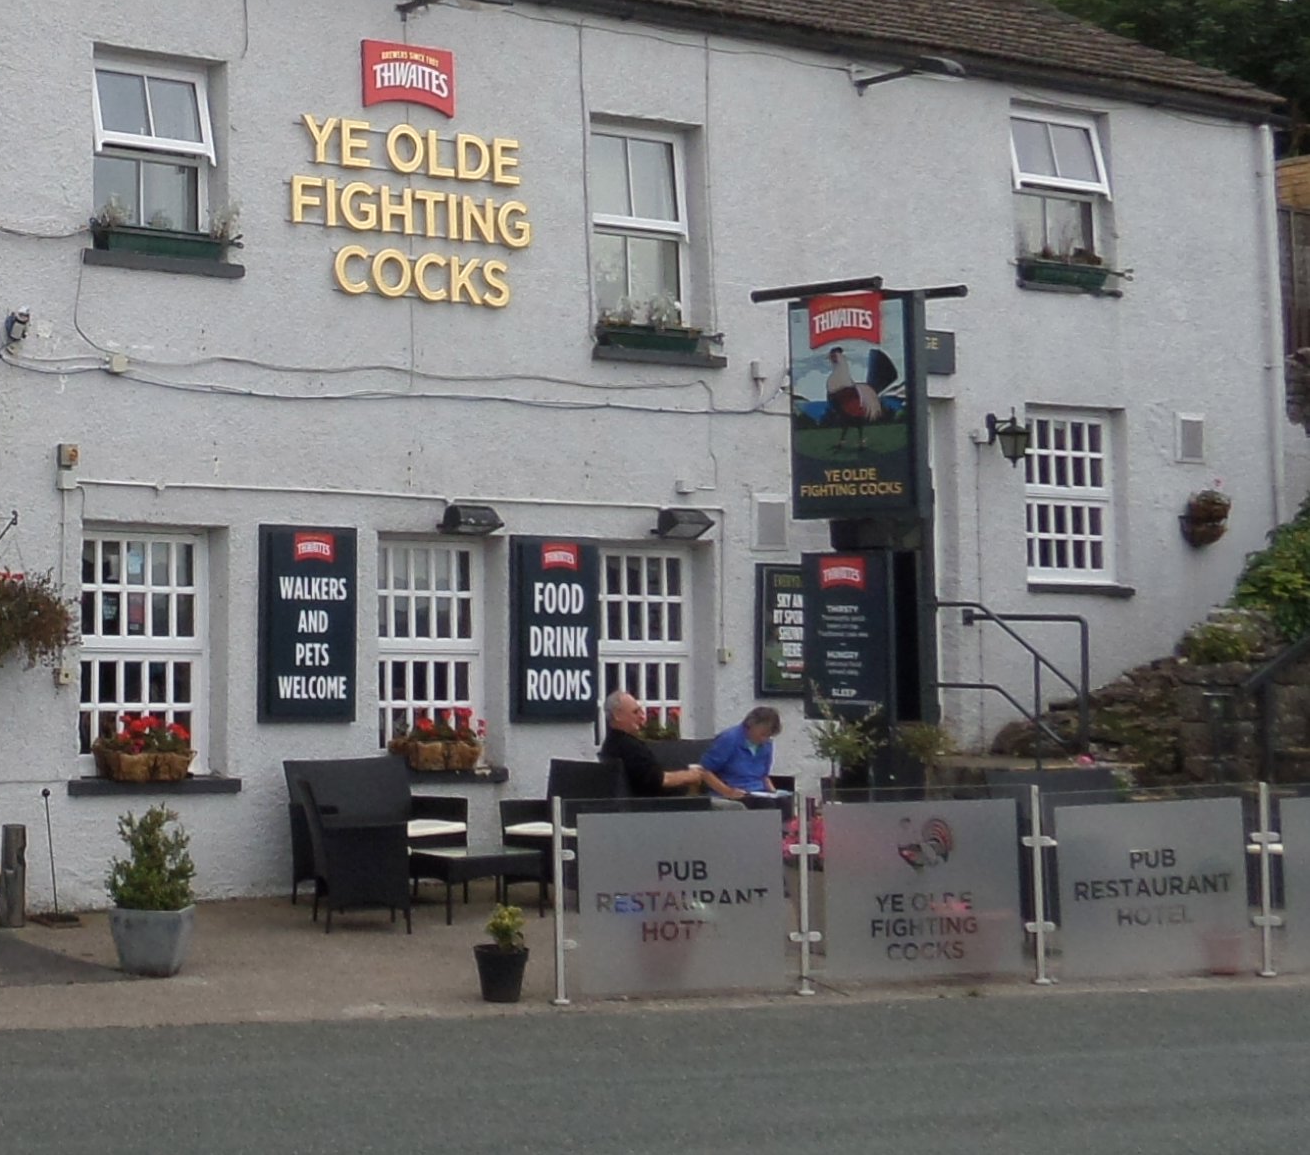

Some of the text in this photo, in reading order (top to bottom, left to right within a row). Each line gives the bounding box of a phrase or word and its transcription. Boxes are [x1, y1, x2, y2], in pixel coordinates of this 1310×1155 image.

[373, 62, 448, 98] THWAITES
[301, 113, 521, 185] YE OLDE
[292, 175, 531, 248] FIGHTING
[334, 245, 510, 307] COCKS
[813, 308, 873, 334] THWAITES
[824, 467, 877, 482] YE OLDE
[800, 482, 903, 497] FIGHTING COCKS
[279, 576, 347, 601] WALKERS
[534, 582, 584, 614] FOOD
[792, 593, 803, 608] AN
[297, 610, 328, 633] AND
[530, 625, 589, 658] DRINK
[295, 642, 330, 666] PETS
[278, 675, 347, 699] WELCOME
[526, 668, 592, 701] ROOMS
[657, 860, 708, 881] PUB
[1130, 848, 1176, 869] PUB
[1074, 873, 1232, 901] RESTAURANT
[876, 894, 904, 913] YE
[1117, 904, 1192, 926] HOTEL
[871, 917, 978, 937] FIGHTING
[887, 941, 964, 960] COCKS
